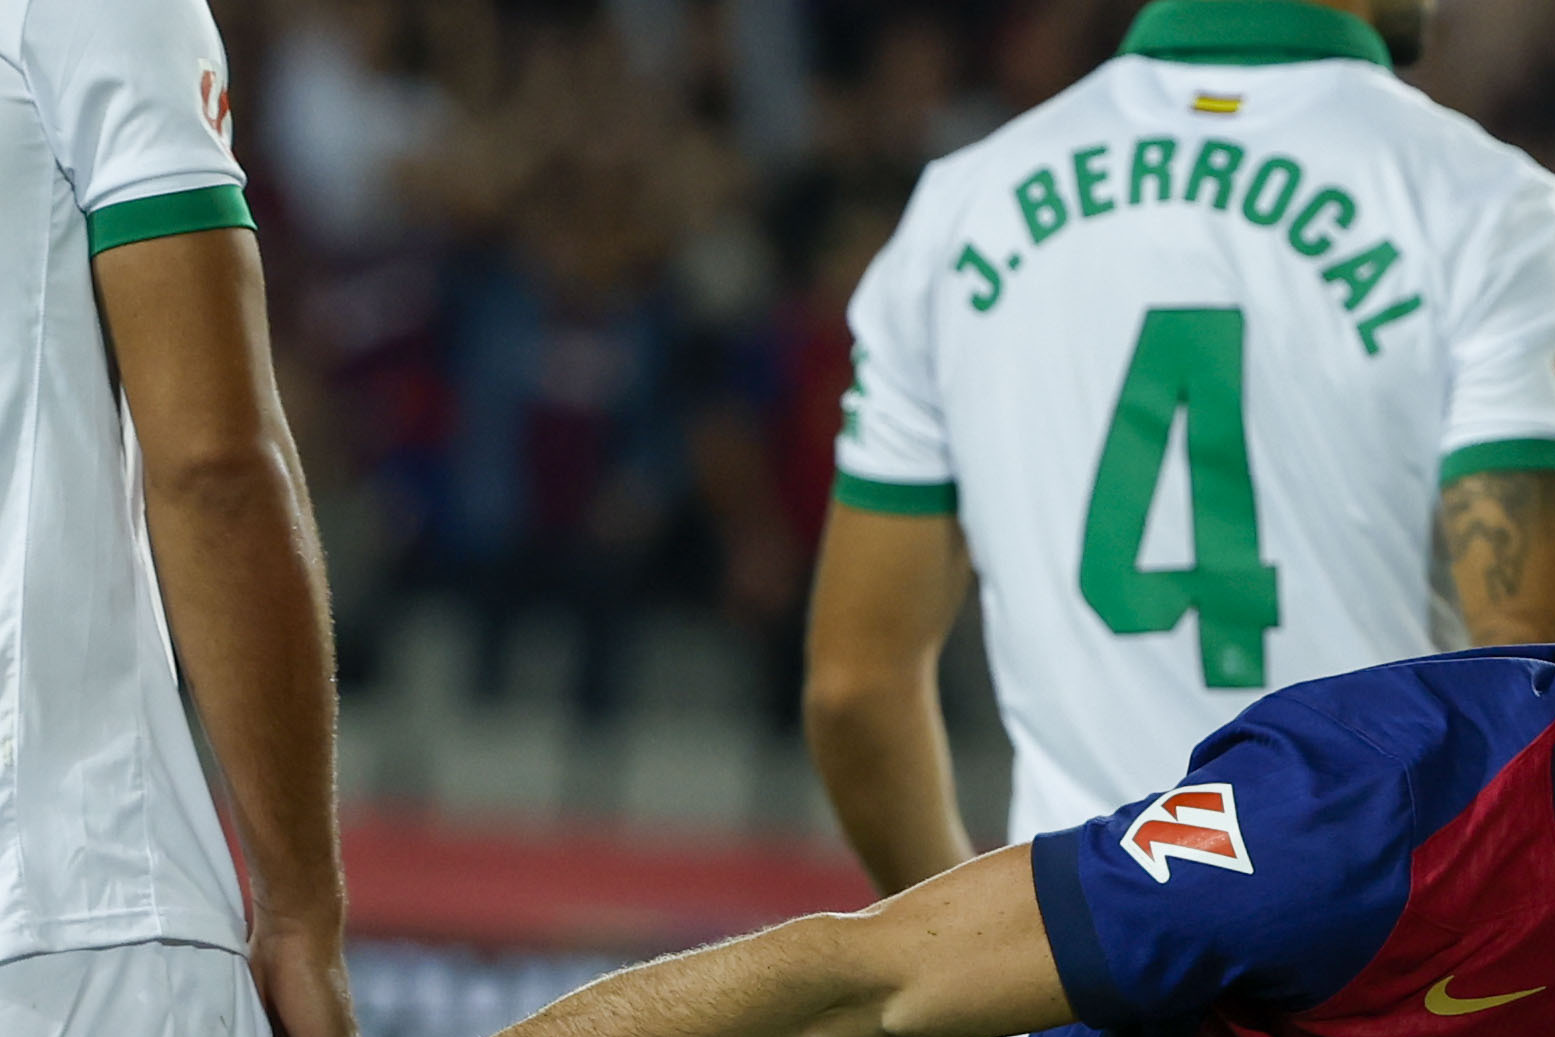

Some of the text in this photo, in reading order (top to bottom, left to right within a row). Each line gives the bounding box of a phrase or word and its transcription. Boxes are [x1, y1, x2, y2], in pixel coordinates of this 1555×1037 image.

[953, 135, 1426, 357] J. BERROCAL
[1079, 306, 1280, 689] 4
